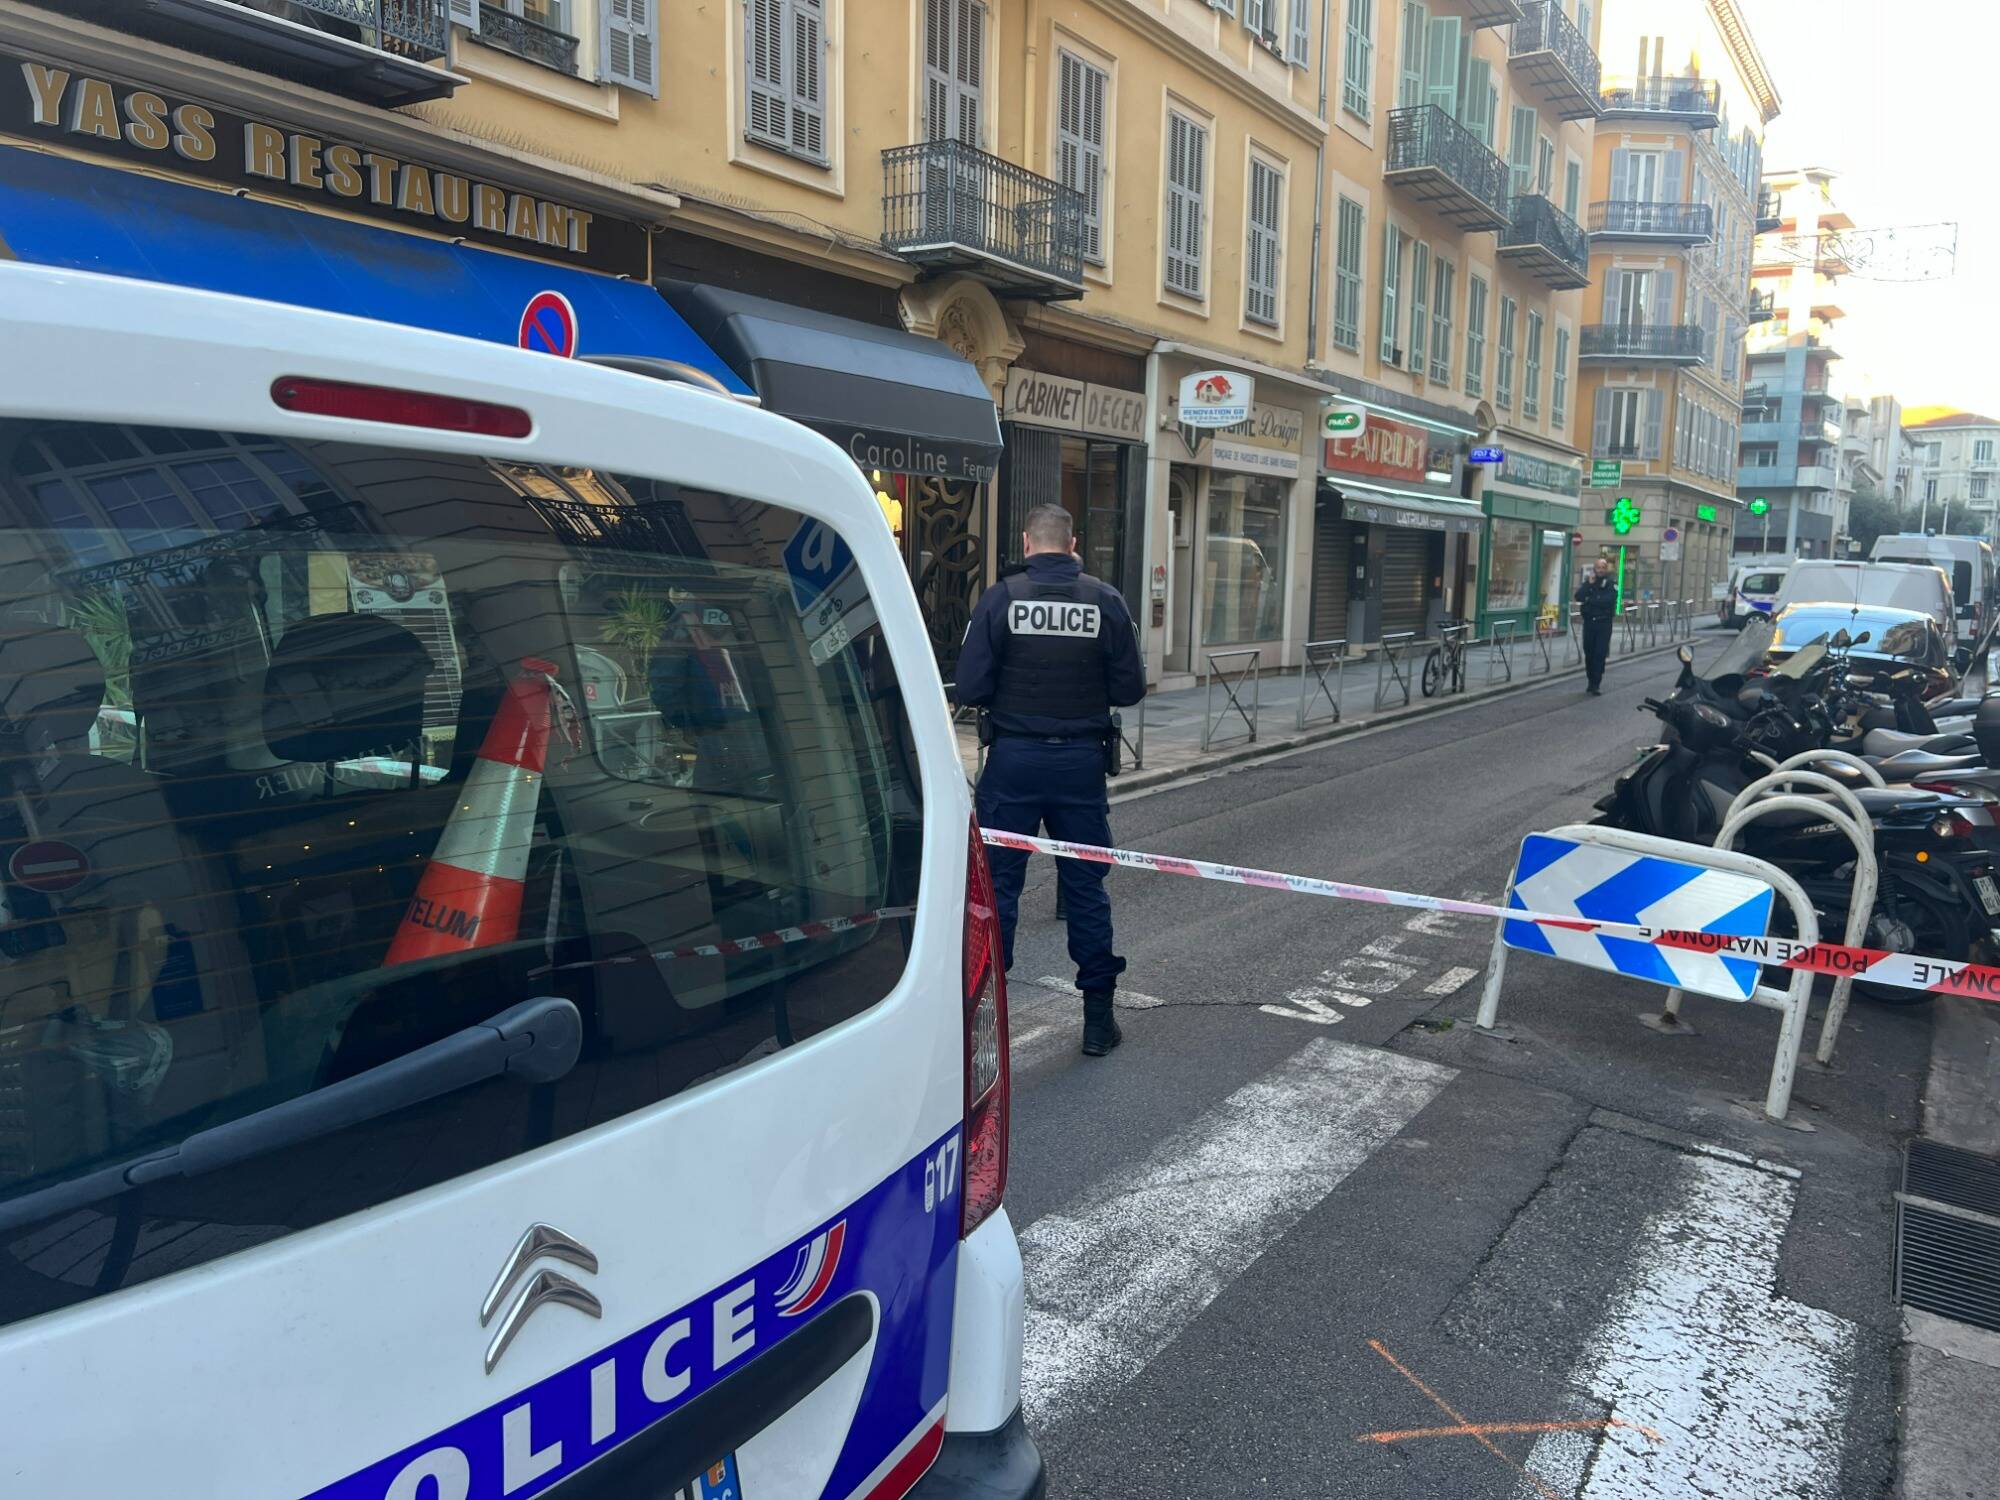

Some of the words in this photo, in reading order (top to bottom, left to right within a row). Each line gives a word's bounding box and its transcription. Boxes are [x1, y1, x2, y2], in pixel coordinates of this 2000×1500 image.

[21, 62, 216, 161] YASS
[244, 121, 592, 253] RESTAURANT
[1016, 378, 1082, 421] CABINET
[1183, 408, 1231, 416] RENOVATION
[1259, 410, 1299, 448] Design
[851, 433, 948, 474] Caroline
[1014, 604, 1095, 633] POLICE
[1776, 942, 1869, 974] POLICE
